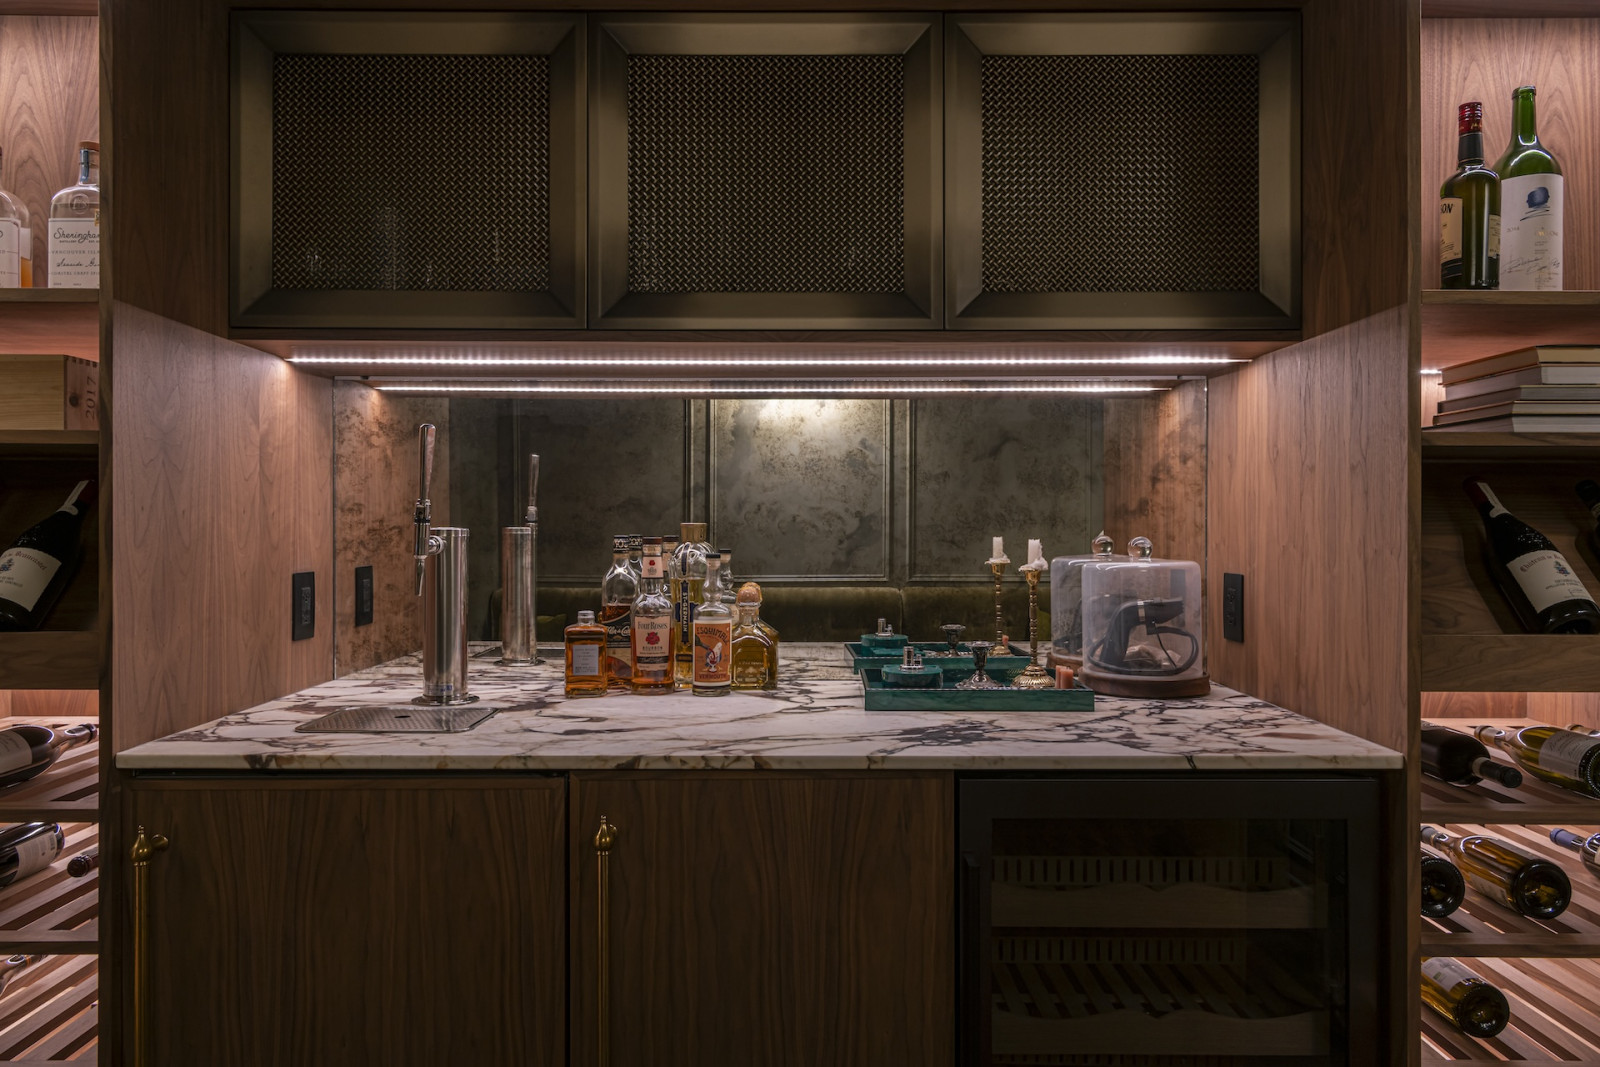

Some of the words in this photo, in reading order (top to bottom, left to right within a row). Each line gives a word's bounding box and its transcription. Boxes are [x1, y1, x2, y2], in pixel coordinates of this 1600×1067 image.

[86, 375, 97, 421] 2017
[637, 621, 650, 630] Four
[650, 621, 668, 630] Roses
